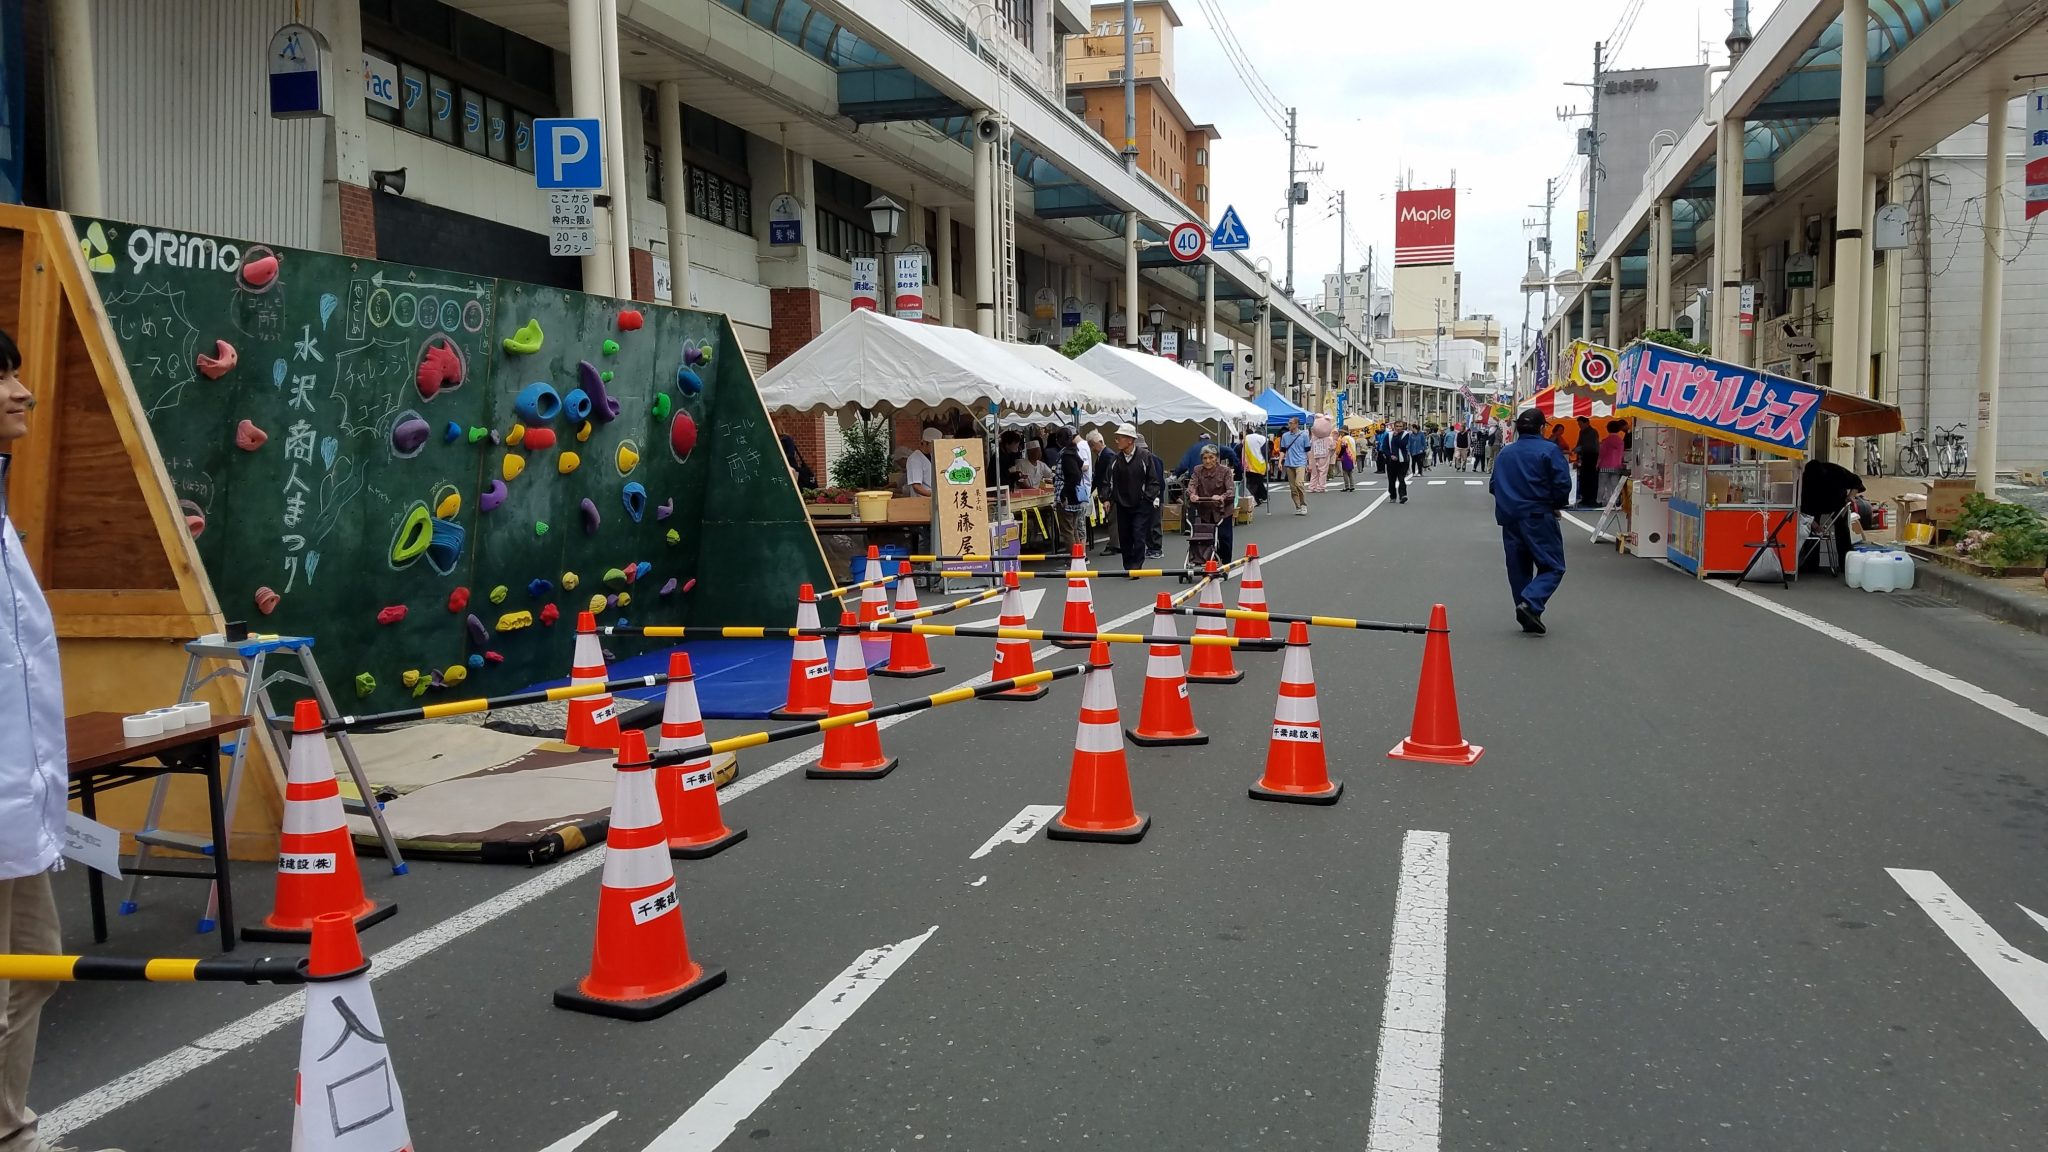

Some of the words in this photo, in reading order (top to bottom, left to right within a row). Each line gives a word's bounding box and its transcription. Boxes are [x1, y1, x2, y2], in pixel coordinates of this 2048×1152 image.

[404, 76, 531, 151] アフラック
[551, 126, 589, 182] P
[551, 194, 590, 204] ここから
[552, 215, 591, 225] 枠内に限る
[1400, 205, 1452, 225] Maple
[553, 244, 592, 254] タクシー
[1178, 233, 1198, 250] 40
[855, 262, 874, 272] ILC
[898, 260, 918, 269] ILC
[345, 354, 407, 390] チャレンジ
[358, 393, 394, 422] コース
[1632, 350, 1820, 446] トロピカルジュース
[282, 324, 324, 594] 水沢商人まつり
[953, 489, 976, 556] 後藤屋
[316, 995, 394, 1137] 入口
